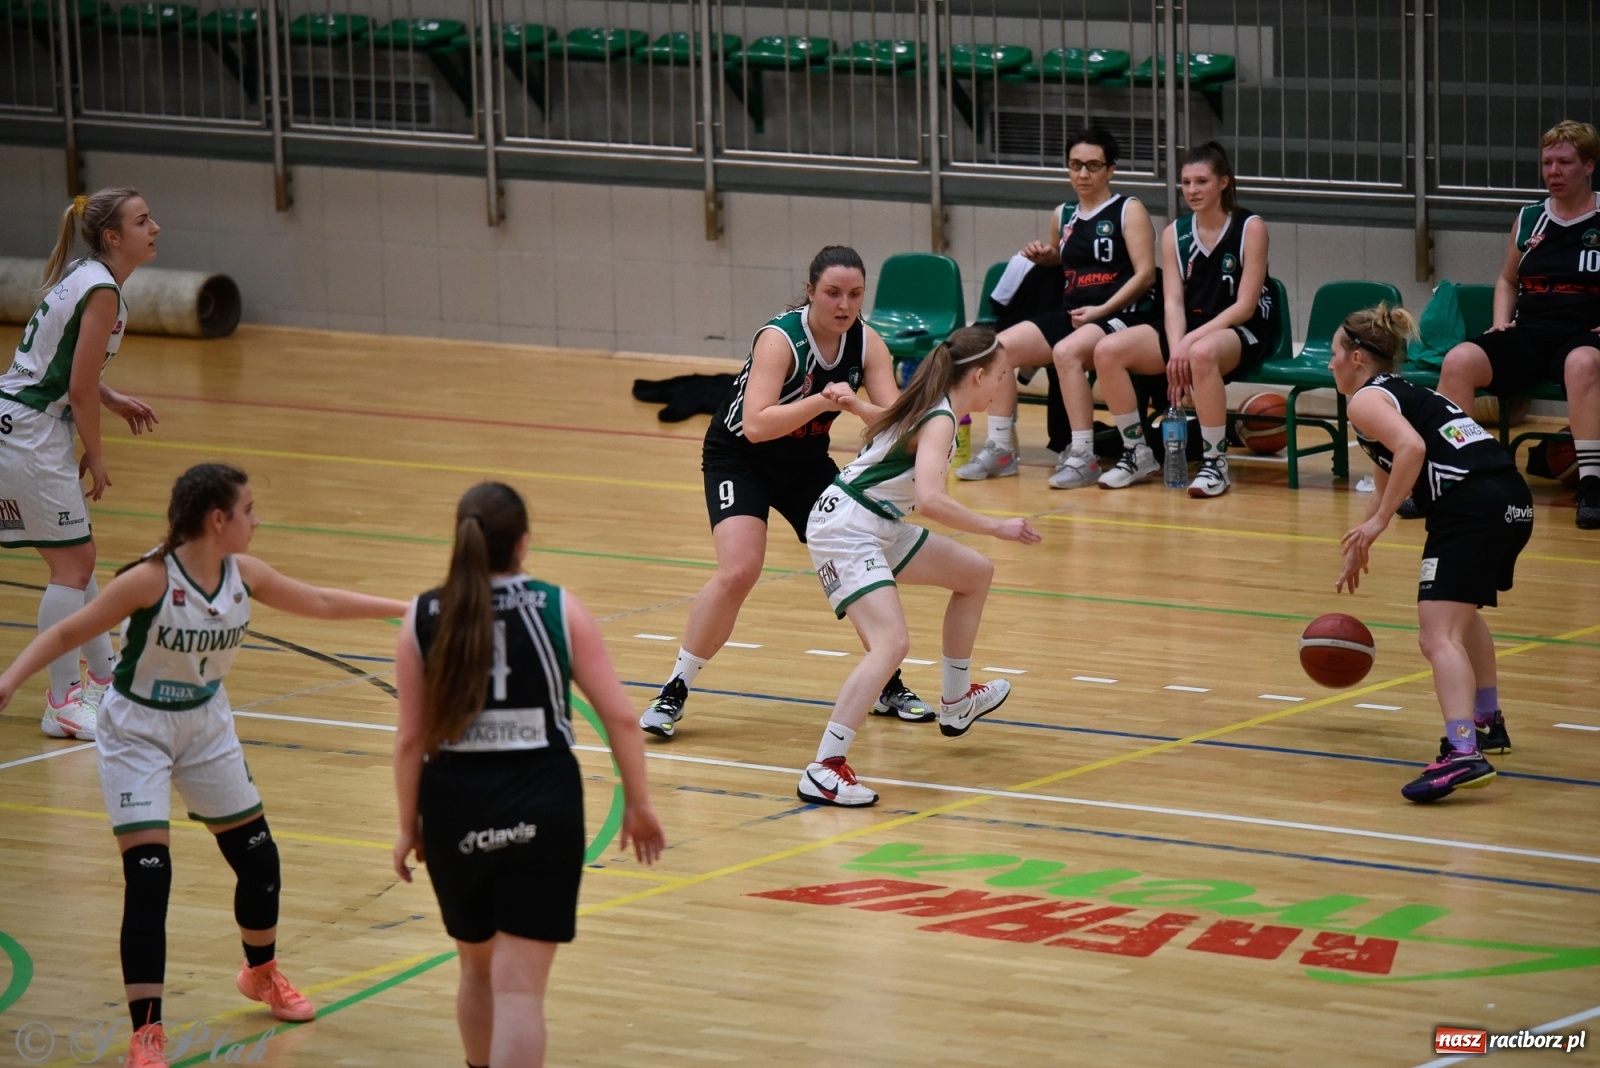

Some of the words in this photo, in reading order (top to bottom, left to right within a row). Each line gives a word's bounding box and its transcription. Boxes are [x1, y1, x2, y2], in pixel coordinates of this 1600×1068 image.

[1093, 237, 1114, 262] 13
[1577, 249, 1600, 273] 10
[718, 479, 735, 511] 9
[158, 684, 197, 699] max
